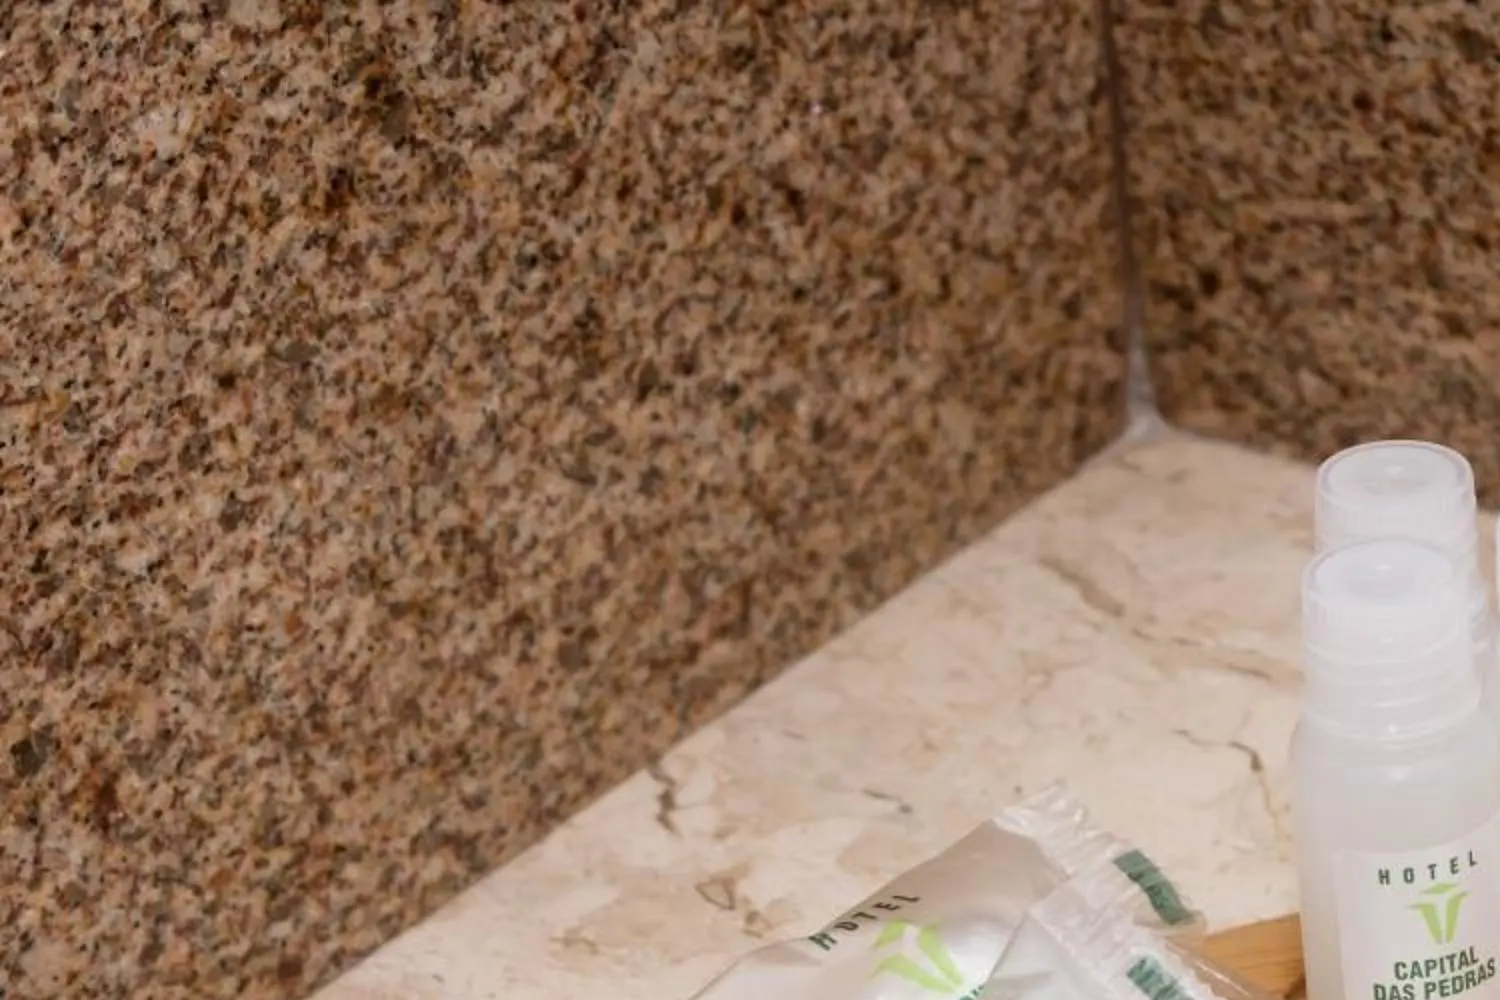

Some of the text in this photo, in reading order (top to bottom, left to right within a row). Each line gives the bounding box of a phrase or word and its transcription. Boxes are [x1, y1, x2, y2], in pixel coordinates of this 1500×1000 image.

[1378, 850, 1477, 885] HOTEL
[1394, 946, 1479, 980] CAPITAL
[1424, 957, 1496, 1000] PEDRAS
